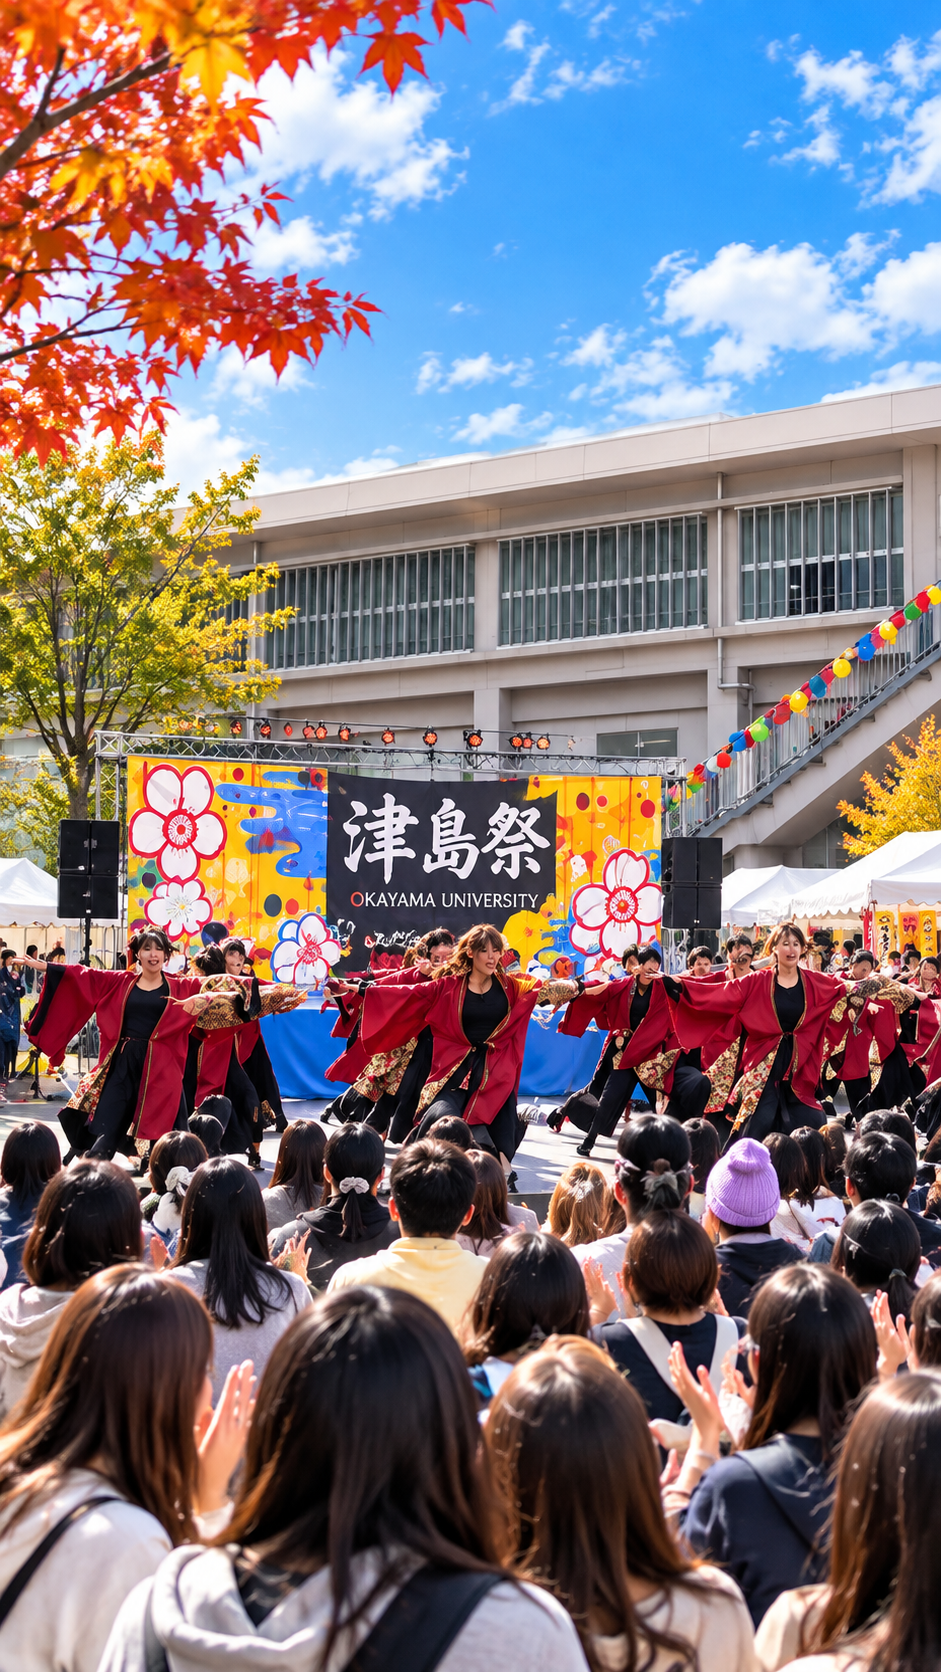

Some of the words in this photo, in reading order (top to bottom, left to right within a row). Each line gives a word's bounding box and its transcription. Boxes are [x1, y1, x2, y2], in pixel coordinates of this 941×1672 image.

[342, 792, 552, 885] 津島祭
[350, 891, 436, 908] OKAYAMA
[441, 892, 539, 909] UNIVERSITY
